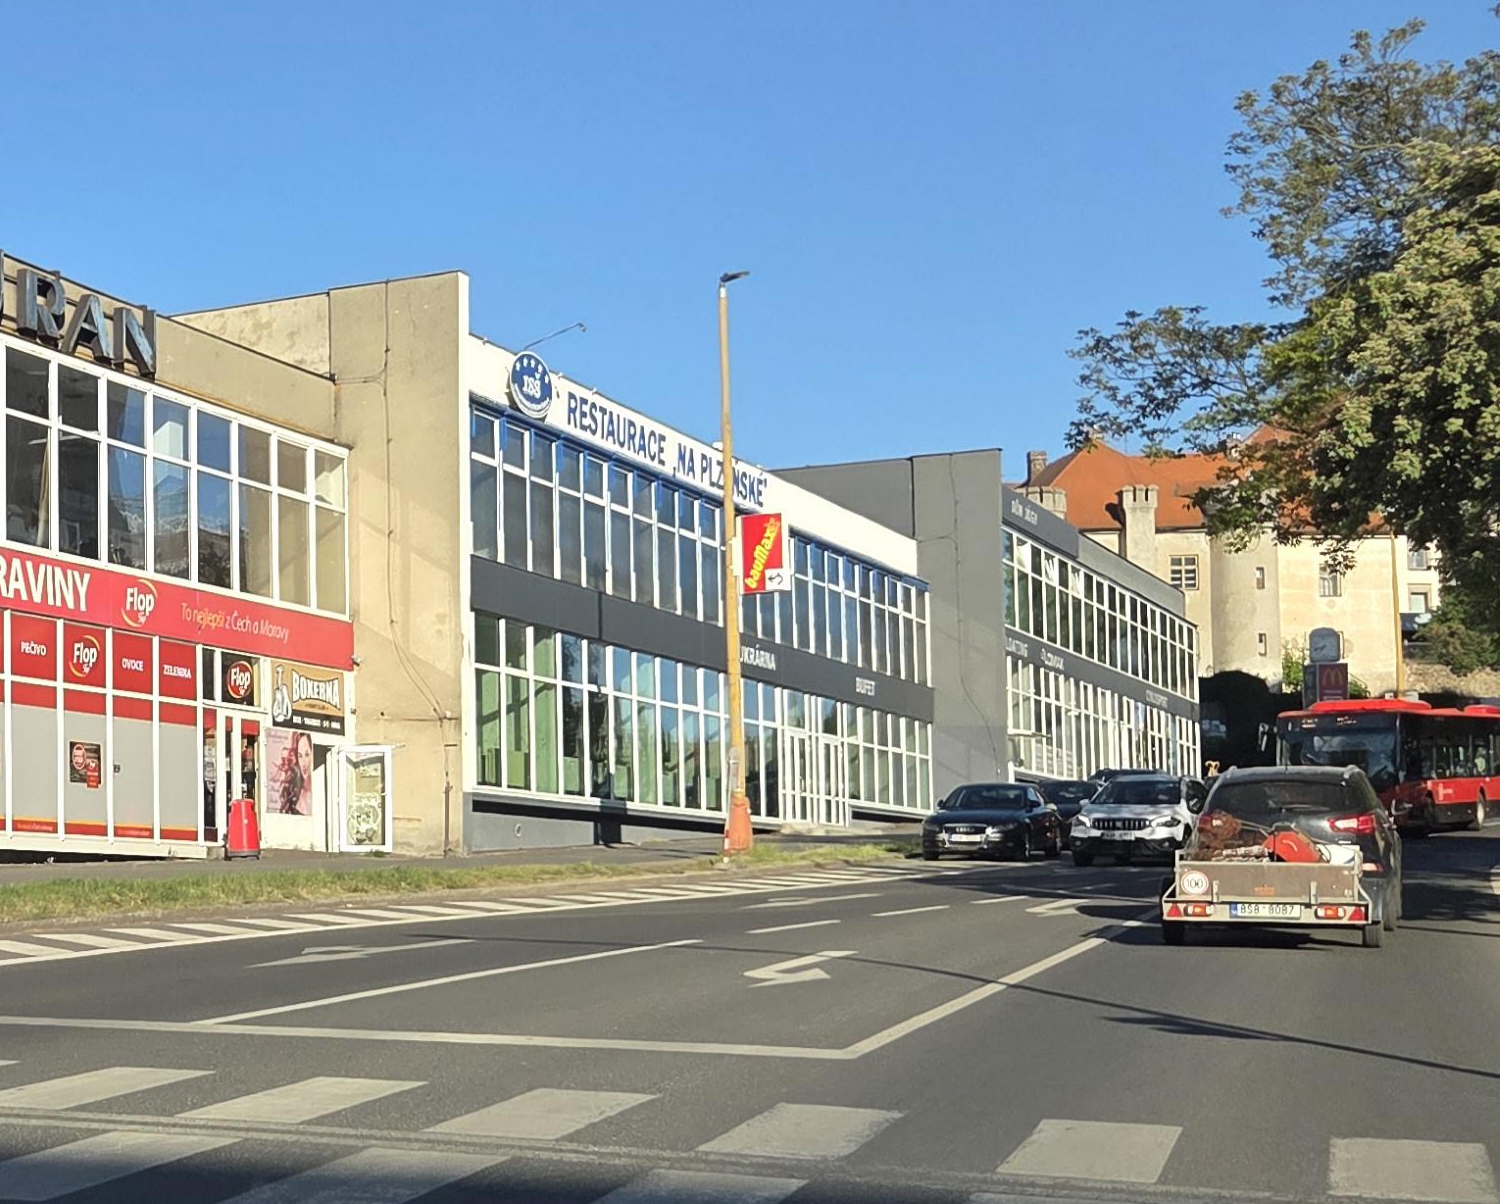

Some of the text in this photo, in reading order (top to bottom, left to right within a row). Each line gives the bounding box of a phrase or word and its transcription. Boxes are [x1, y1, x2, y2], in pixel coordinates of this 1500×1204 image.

[567, 391, 667, 467] RESTAURACE
[126, 587, 155, 617] Flop
[181, 602, 191, 621] To
[193, 606, 225, 630] nejlepší
[231, 610, 251, 633] Čech
[253, 622, 259, 633] a
[260, 620, 289, 644] Moravy
[20, 641, 47, 656] PEČIVO
[73, 642, 98, 669] Flop
[121, 658, 144, 672] OVOCE
[231, 669, 251, 691] Flop
[291, 668, 341, 711] BOXERNA
[1186, 877, 1204, 890] 100
